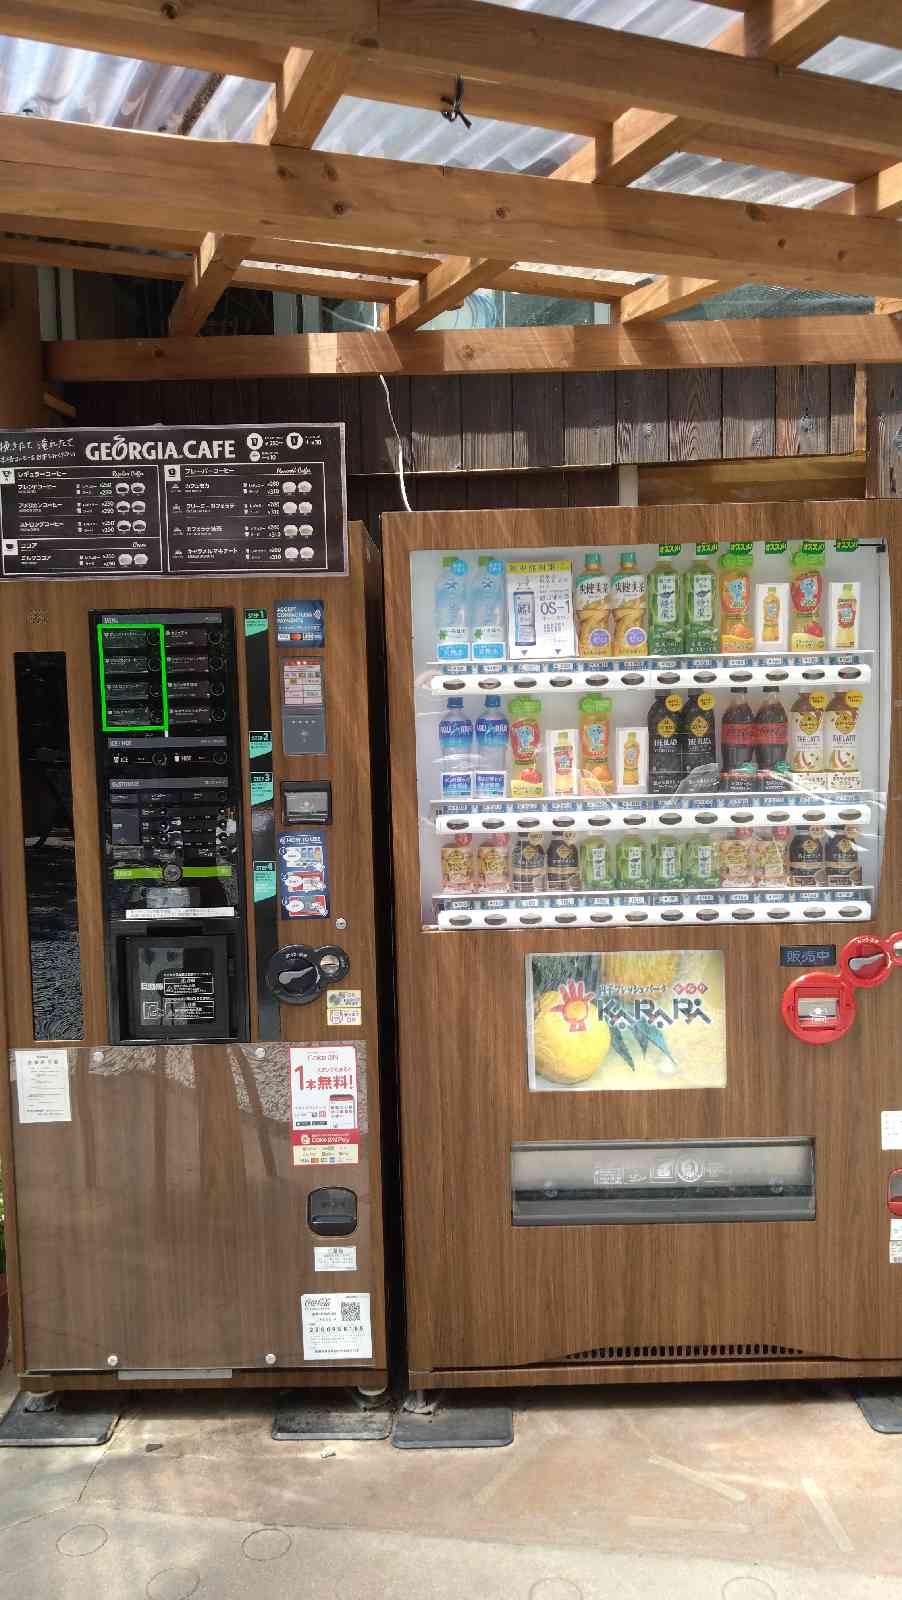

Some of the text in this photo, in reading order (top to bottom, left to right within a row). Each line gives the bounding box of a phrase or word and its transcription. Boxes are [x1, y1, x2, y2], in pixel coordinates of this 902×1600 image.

[85, 435, 236, 461] GEORGIA CAFE
[540, 599, 570, 615] OS-1
[264, 774, 271, 782] 3
[786, 950, 831, 964] 販売中
[294, 1065, 353, 1090] 1本無料!
